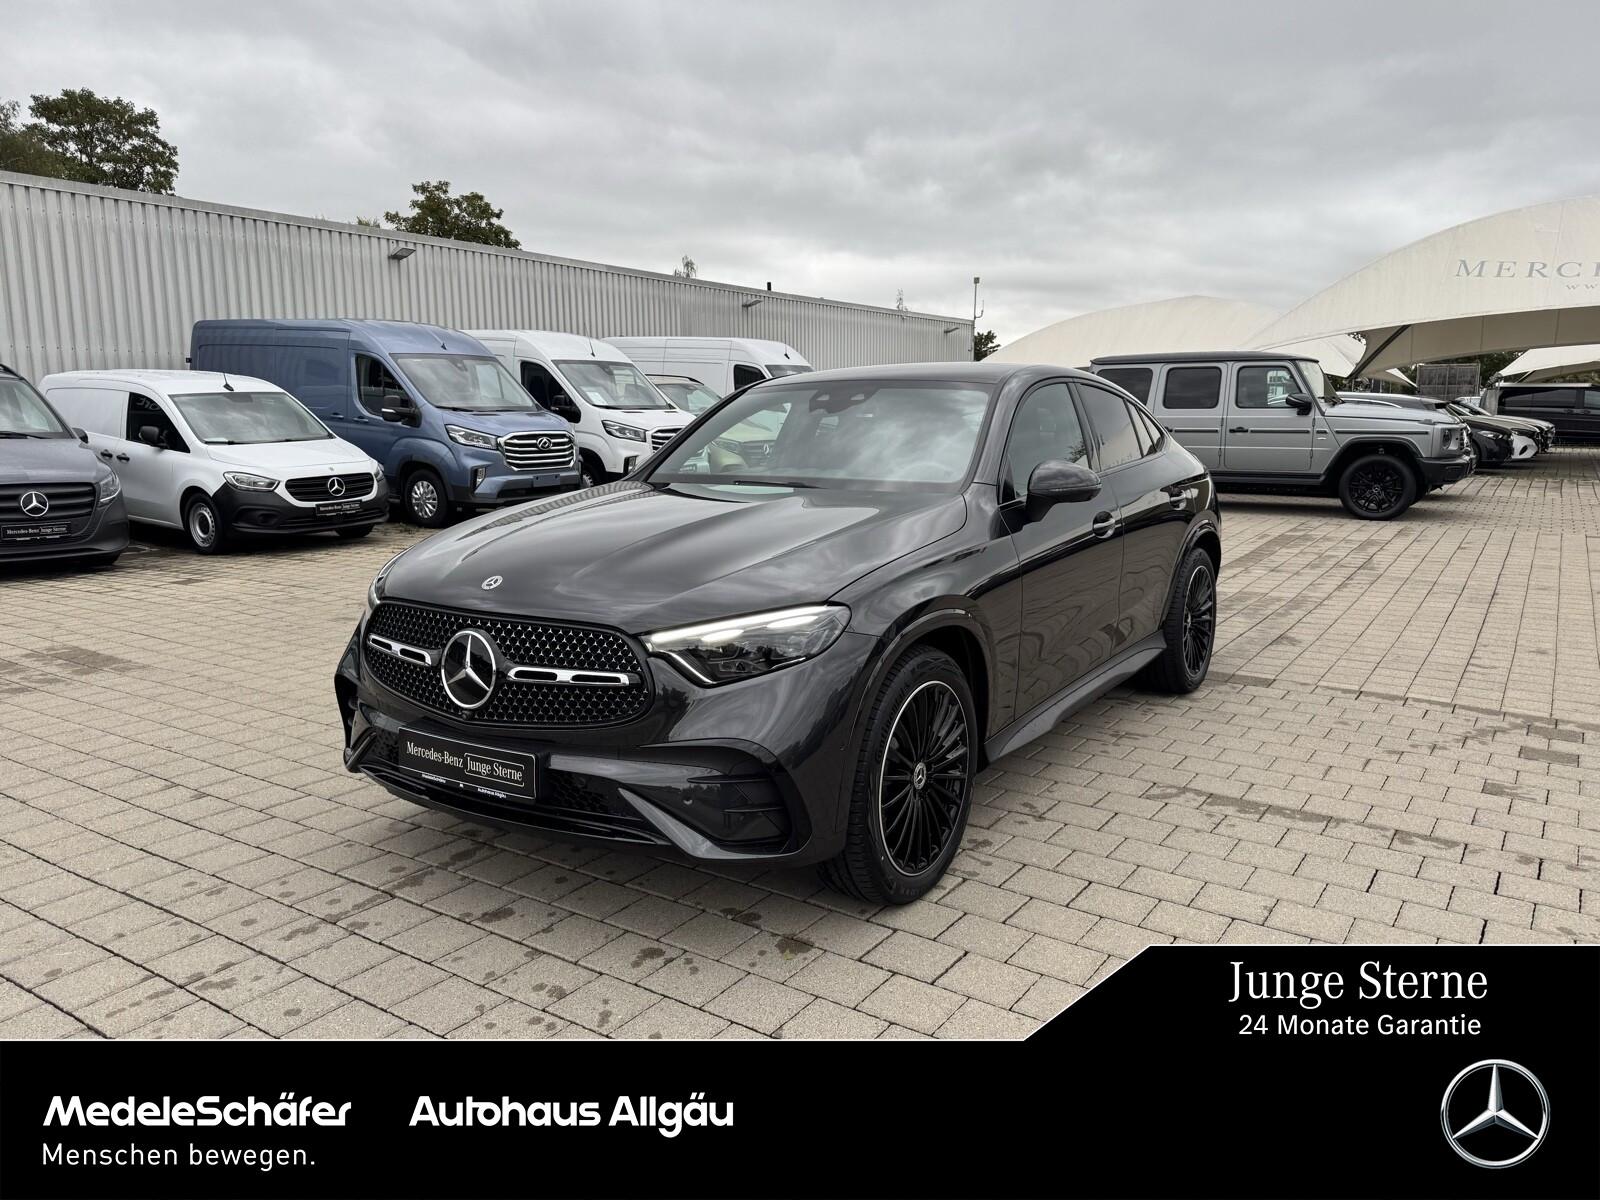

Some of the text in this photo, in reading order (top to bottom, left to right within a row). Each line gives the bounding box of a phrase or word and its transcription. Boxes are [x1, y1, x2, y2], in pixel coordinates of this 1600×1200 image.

[406, 741, 523, 781] Mercedes-Benz Junge Sterne
